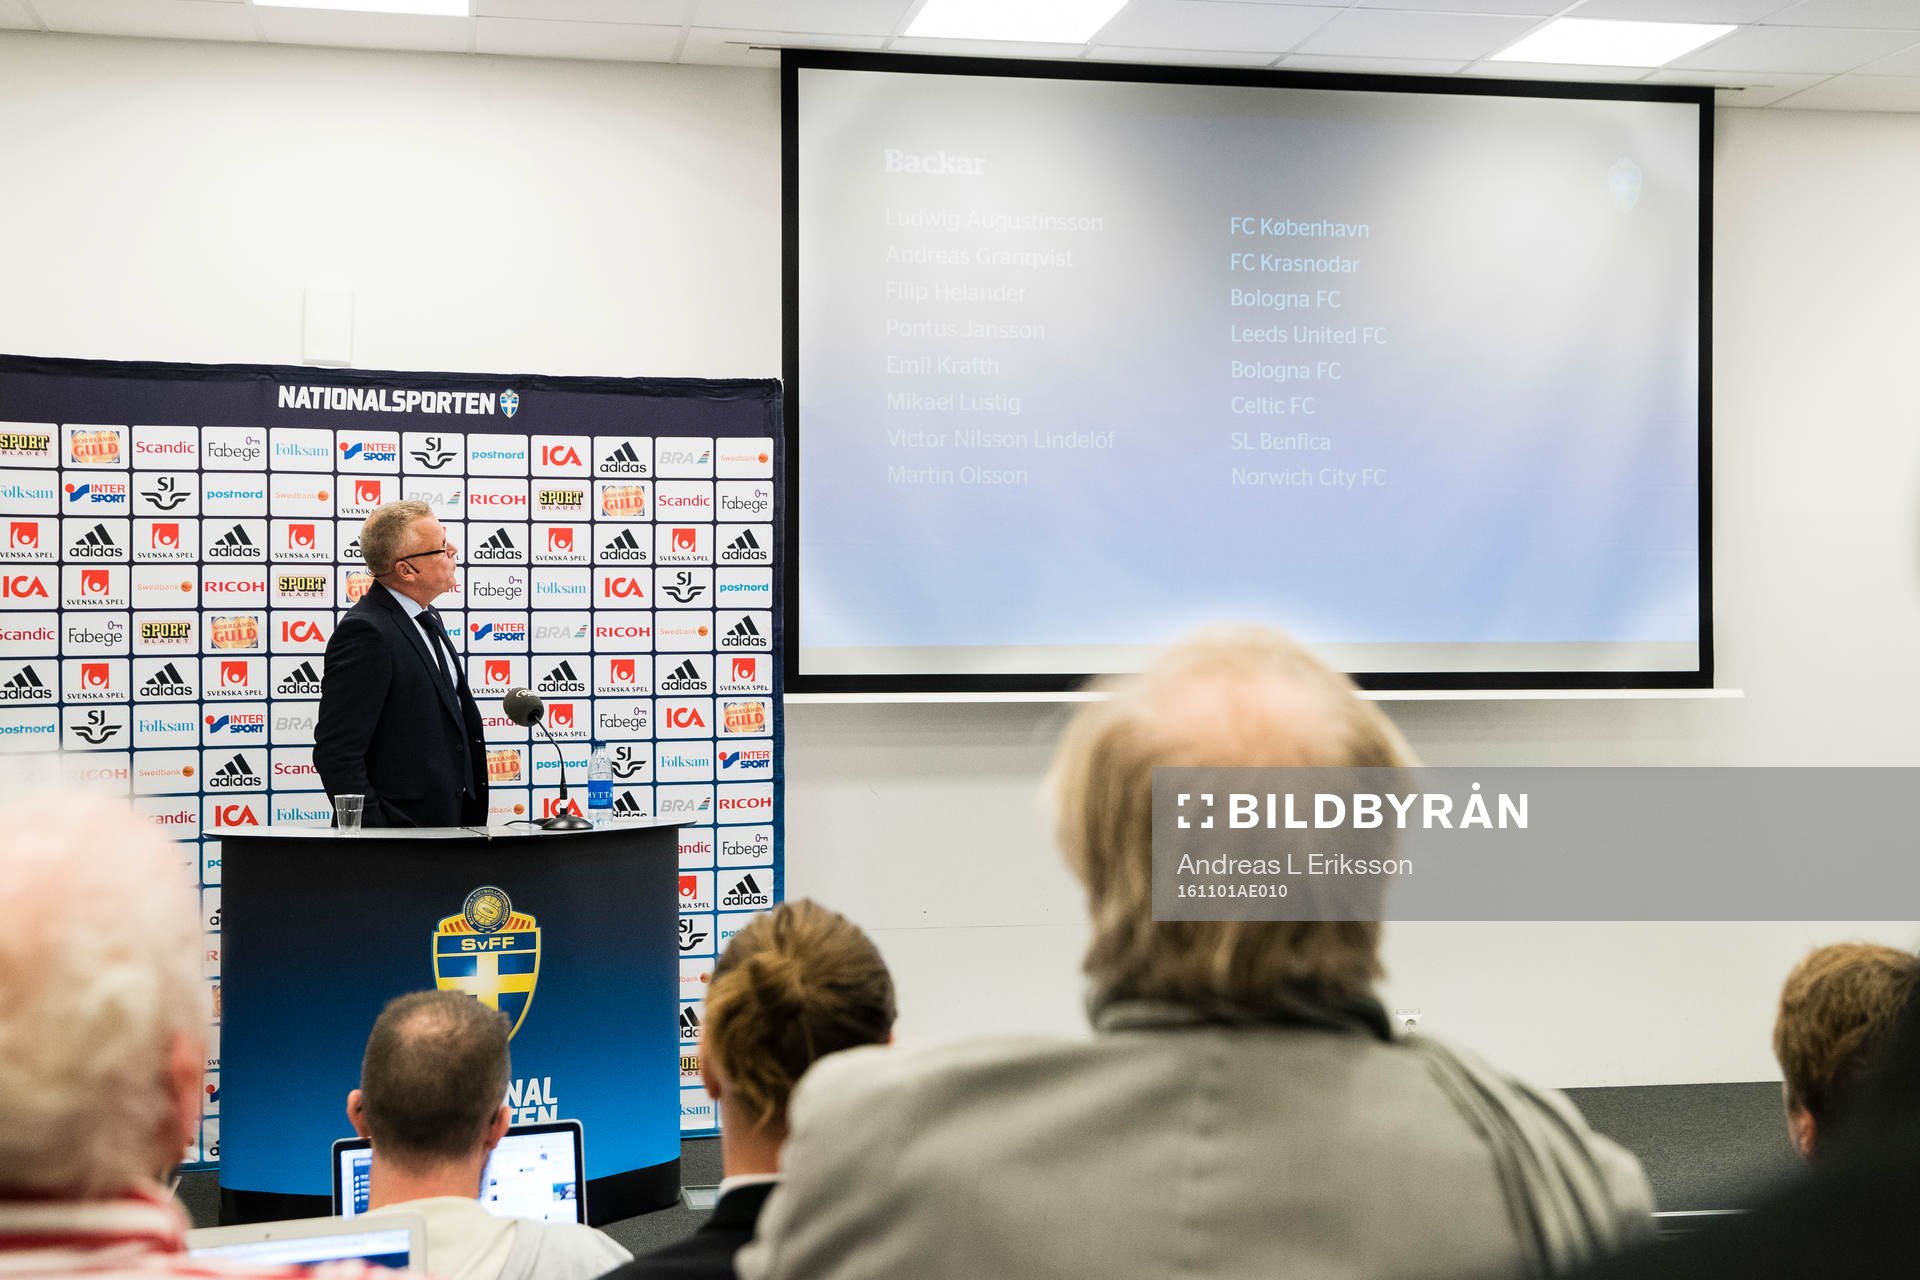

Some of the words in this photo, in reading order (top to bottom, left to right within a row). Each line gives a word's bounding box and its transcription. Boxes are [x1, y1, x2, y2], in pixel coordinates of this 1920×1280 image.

[884, 148, 987, 176] Backar
[885, 207, 960, 231] Ludwig
[967, 209, 1104, 233] Augustinsson
[1230, 217, 1255, 235] FC
[1260, 218, 1369, 238] København
[885, 244, 970, 265] Andreas
[976, 247, 1073, 270] Granqvist
[1230, 253, 1255, 271] FC
[1260, 254, 1360, 273] Krasnodar
[886, 280, 928, 303] Filip
[935, 281, 1027, 302] Helander
[1231, 288, 1310, 311] Bologna
[1316, 290, 1341, 308] FC
[886, 319, 957, 338] Pontus
[962, 320, 1046, 340] Jansson
[1231, 324, 1287, 343] Leeds
[1293, 325, 1357, 345] United
[1363, 327, 1388, 345] FC
[886, 355, 930, 375] Emil
[937, 355, 1000, 376] Krafth
[1231, 360, 1310, 382] Bologna
[1317, 361, 1342, 380] FC
[278, 385, 496, 415] NATIONALSPORTEN
[887, 392, 953, 411] Mikael
[960, 393, 1021, 415] Lustig
[1231, 396, 1286, 415] Celtic
[1291, 397, 1316, 415] FC
[0, 434, 50, 451] SPORT
[425, 437, 442, 452] SJ
[887, 429, 947, 448] Victor
[954, 429, 1028, 449] Nilsson
[1034, 430, 1116, 449] Lindelöf
[1231, 432, 1256, 450] SL
[1260, 432, 1331, 451] Benfica
[74, 442, 119, 457] GULD
[136, 441, 196, 455] Scandic
[208, 442, 260, 462] Fabege
[276, 442, 329, 457] Folksam
[363, 442, 396, 452] INTER
[363, 452, 397, 462] SPORT
[471, 450, 525, 460] postnord
[542, 445, 583, 467] ICA
[659, 451, 695, 465] BRA
[720, 454, 757, 463] Swedbank
[600, 460, 647, 473] adidas
[887, 465, 953, 484] Martin
[960, 465, 1028, 485] Olsson
[1231, 467, 1313, 486] Norwich
[1319, 468, 1357, 489] City
[1362, 468, 1388, 486] FC
[90, 483, 126, 494] INTER
[157, 477, 175, 492] SJ
[90, 494, 127, 504] SPORT
[207, 489, 263, 500] postnord
[275, 491, 317, 500] Swedbank
[469, 493, 527, 505] RICOH
[539, 490, 584, 506] SPORT
[658, 494, 711, 507] Scandic
[604, 496, 645, 511] GULD
[721, 495, 768, 513] Fabege
[0, 551, 33, 559] VENSKA
[35, 551, 55, 559] SPEL
[69, 544, 123, 558] adidas
[209, 544, 261, 558] adidas
[474, 547, 523, 560] adidas
[600, 548, 647, 560] adidas
[721, 547, 768, 560] adidas
[278, 576, 326, 592] SPORT
[676, 571, 692, 586] SJ
[3, 575, 49, 598] ICA
[137, 583, 179, 591] Swedbank
[204, 581, 265, 593] RICOH
[473, 582, 522, 600] Fabege
[536, 581, 587, 594] Folksam
[604, 577, 644, 598] ICA
[719, 583, 769, 593] postnord
[141, 623, 191, 639] SPORT
[281, 620, 326, 642] ICA
[493, 622, 525, 632] INTER
[535, 626, 572, 639] BRA
[596, 626, 651, 638] RICOH
[68, 627, 123, 647] Fabege
[213, 628, 258, 643] GULD
[493, 632, 526, 641] SPORT
[721, 635, 767, 647] adidas
[139, 684, 193, 697] adidas
[277, 682, 323, 695] adida
[537, 680, 585, 692] adidas
[661, 678, 708, 691] adidas
[0, 687, 53, 700] adidas
[207, 689, 242, 697] SVENSKA
[87, 710, 106, 726] SJ
[230, 714, 264, 724] INTER
[275, 717, 314, 731] BRA
[599, 713, 647, 731] Fabege
[666, 707, 705, 728] ICA
[726, 713, 765, 727] GULD
[139, 718, 195, 733] Folksam
[229, 724, 265, 734] SPORT
[569, 730, 588, 738] SPEL
[616, 747, 632, 762] SJ
[661, 755, 709, 768] Folksam
[740, 751, 770, 760] INTER
[489, 761, 520, 774] ULD
[740, 759, 770, 769] SPORT
[138, 768, 181, 777] Swedbank
[209, 774, 262, 787] adidas
[660, 799, 695, 812] BRA
[719, 797, 772, 810] RICOH
[215, 805, 260, 827] ICA
[277, 808, 331, 821] Folksam
[678, 841, 711, 854] andic
[722, 841, 768, 858] Fabege
[722, 894, 769, 906] adidas
[679, 919, 694, 934] SJ
[461, 936, 515, 951] SvFF
[680, 1103, 711, 1115] ksam
